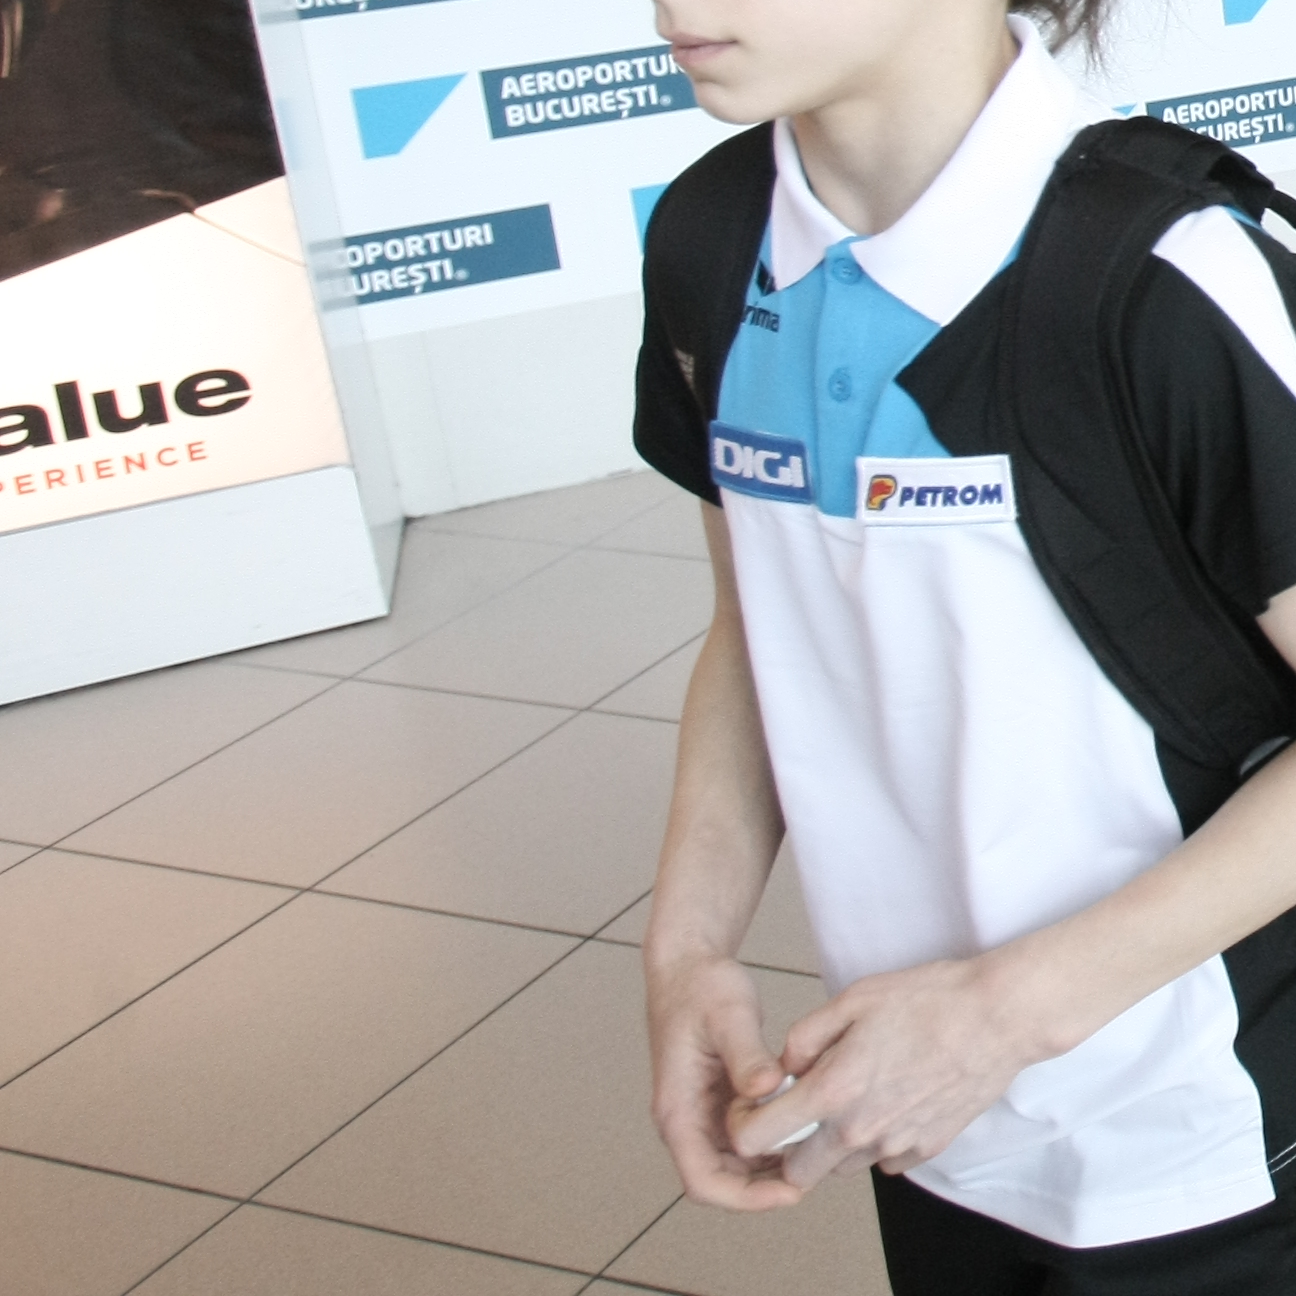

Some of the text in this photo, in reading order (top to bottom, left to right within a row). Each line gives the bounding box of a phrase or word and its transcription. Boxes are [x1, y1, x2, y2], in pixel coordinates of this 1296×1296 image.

[501, 53, 685, 99] AEROPORTUR
[1190, 113, 1284, 143] UREȘTI
[345, 222, 494, 268] OPORTURI
[352, 258, 454, 295] UREȘTI
[743, 302, 779, 333] rima
[0, 440, 208, 496] ERIENCE
[713, 437, 805, 488] DIGI
[899, 483, 1002, 507] PETROM
